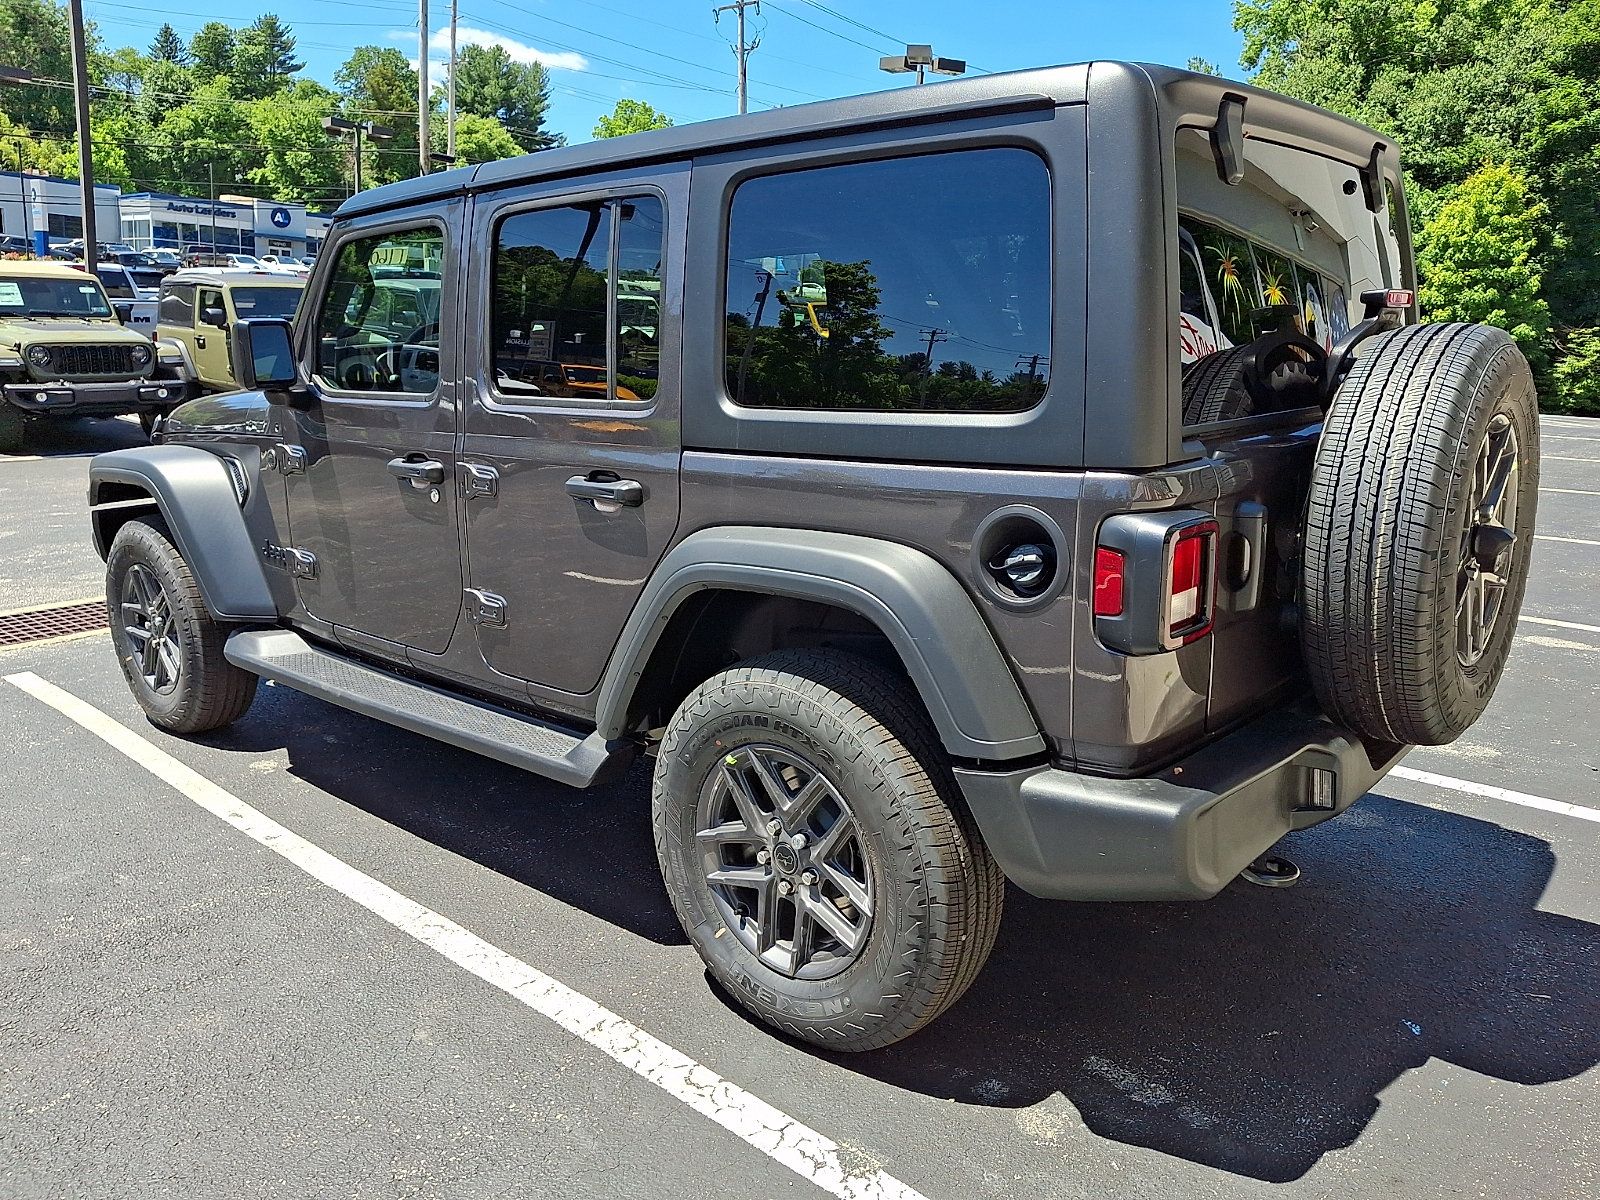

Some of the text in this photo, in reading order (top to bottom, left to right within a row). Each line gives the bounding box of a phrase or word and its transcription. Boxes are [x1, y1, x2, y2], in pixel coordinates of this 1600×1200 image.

[166, 202, 237, 219] Auto Lenders
[739, 974, 844, 1017] NEXEN
